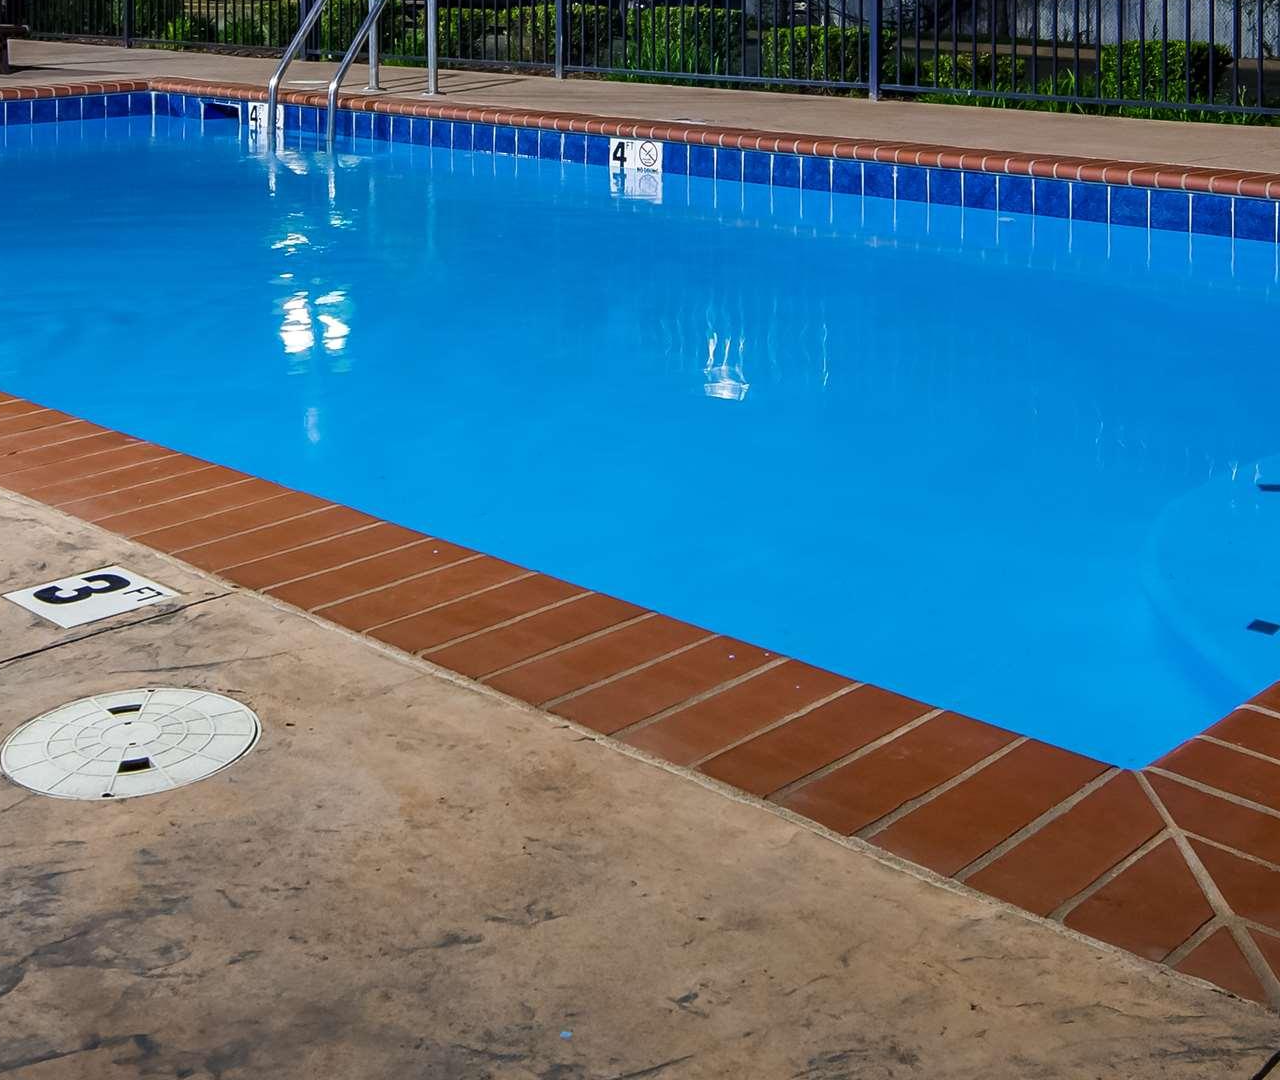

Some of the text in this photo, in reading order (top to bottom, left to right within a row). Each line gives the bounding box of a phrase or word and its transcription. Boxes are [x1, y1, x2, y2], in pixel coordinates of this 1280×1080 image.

[613, 142, 633, 167] 4 FT
[33, 574, 163, 605] 3 FT
